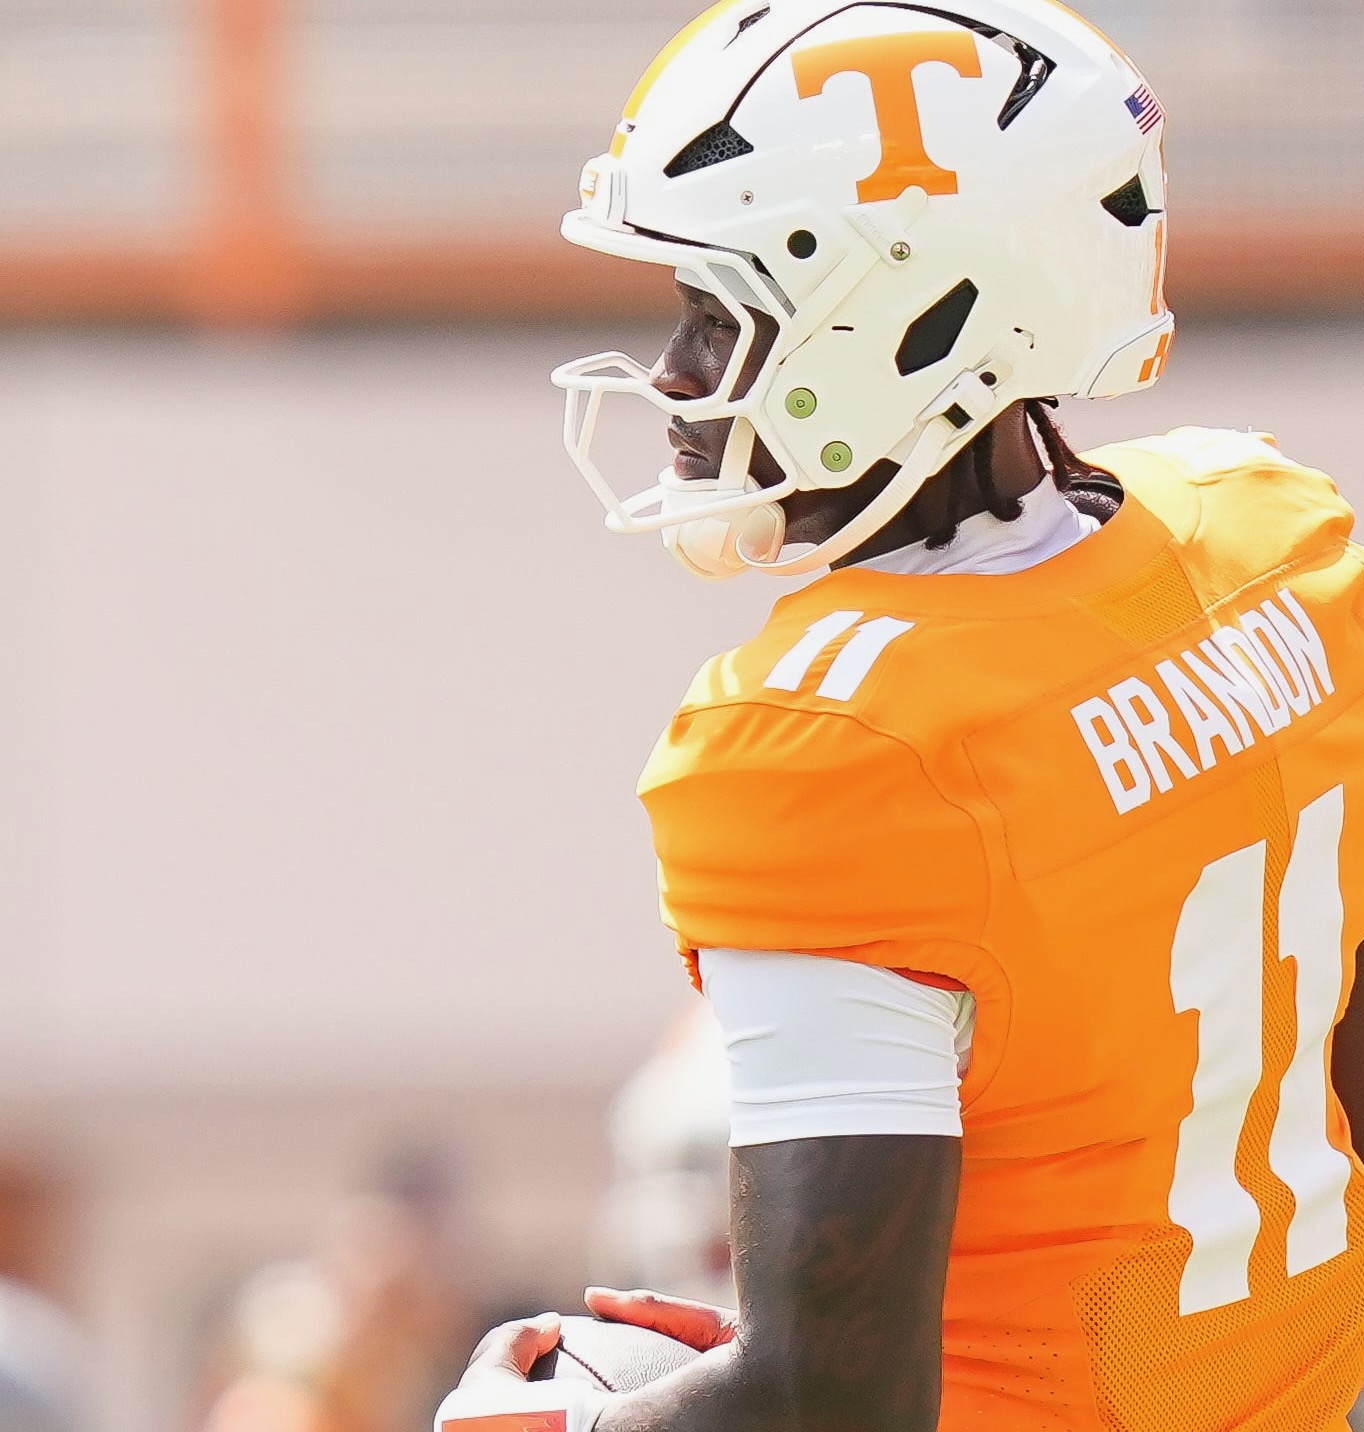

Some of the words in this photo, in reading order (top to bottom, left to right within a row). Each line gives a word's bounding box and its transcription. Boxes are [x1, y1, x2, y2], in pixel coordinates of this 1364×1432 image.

[791, 31, 982, 203] T
[762, 610, 915, 702] 11
[1070, 587, 1335, 816] BRANDON
[1168, 783, 1352, 1317] 11
